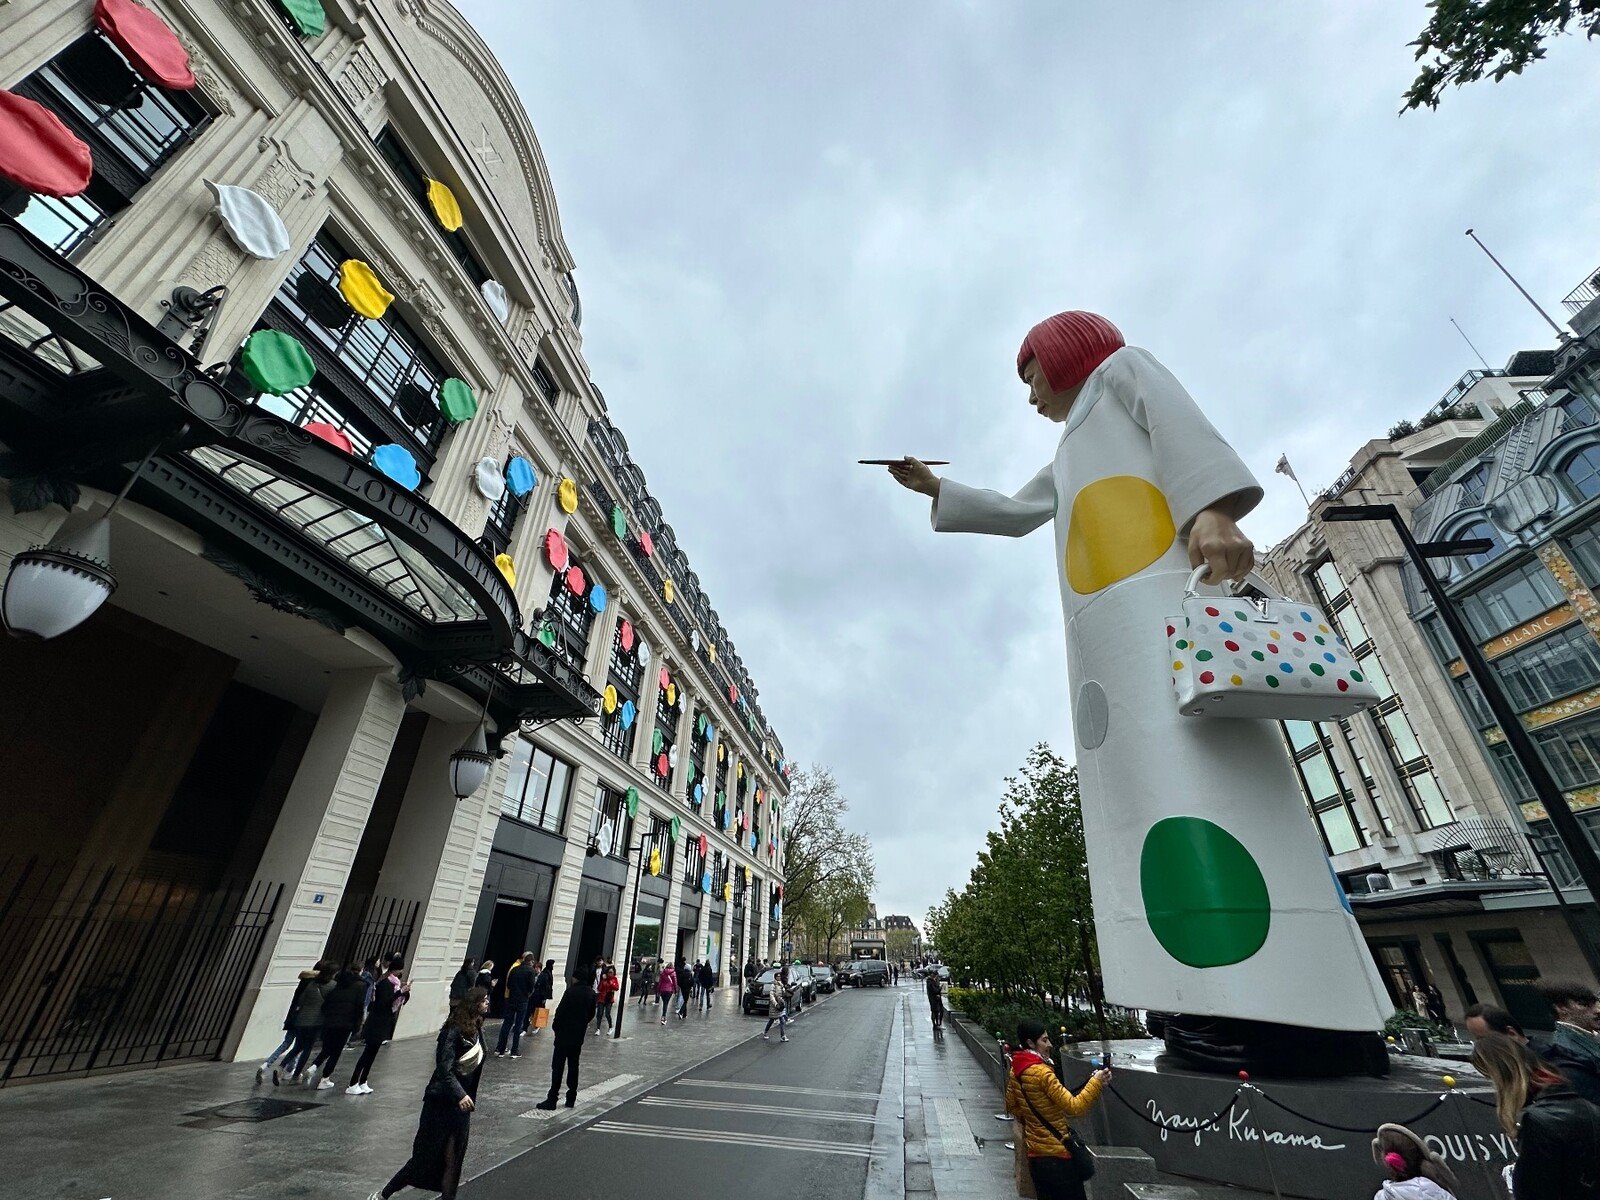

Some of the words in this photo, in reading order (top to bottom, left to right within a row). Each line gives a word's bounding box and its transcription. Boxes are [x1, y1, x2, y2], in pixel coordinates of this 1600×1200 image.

[339, 463, 433, 535] LOUIS
[452, 537, 513, 617] VUITTON
[1502, 616, 1554, 647] BLANC
[1422, 1134, 1491, 1161] OUIS
